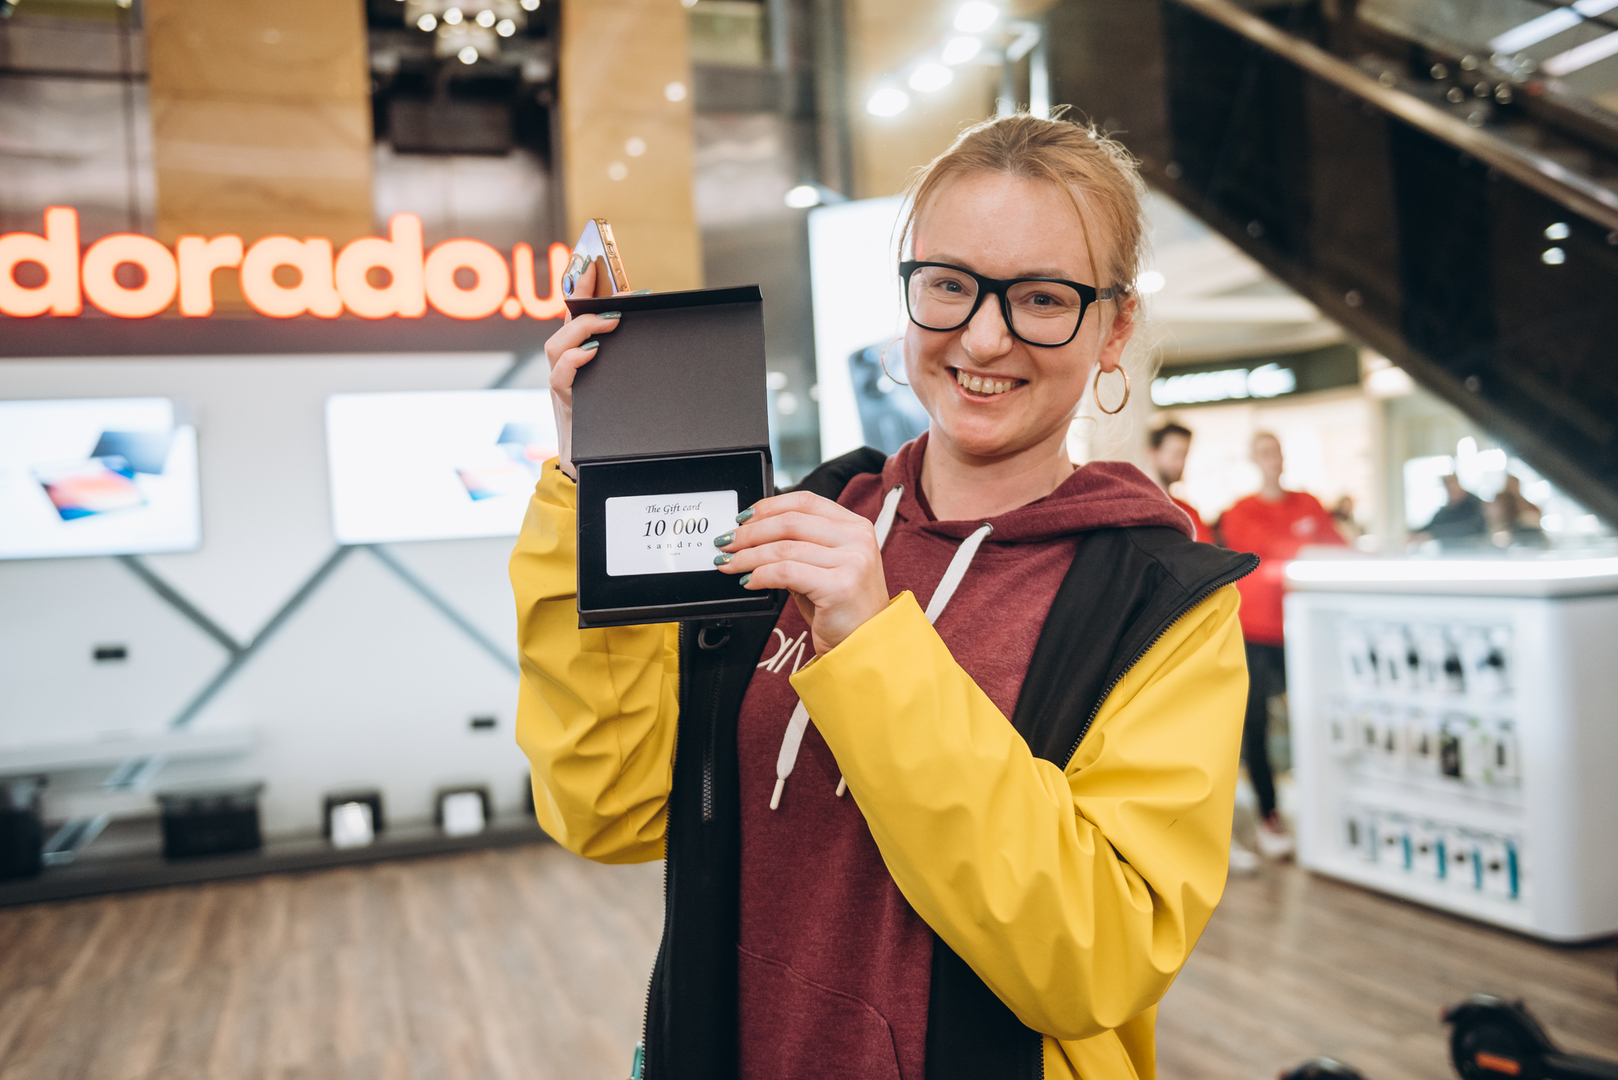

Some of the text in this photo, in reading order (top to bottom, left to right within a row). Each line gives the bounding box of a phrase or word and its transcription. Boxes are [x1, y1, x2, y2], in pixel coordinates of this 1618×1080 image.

[0, 204, 574, 320] dorado.u
[645, 502, 702, 515] The Gift card
[643, 517, 709, 537] 10 000
